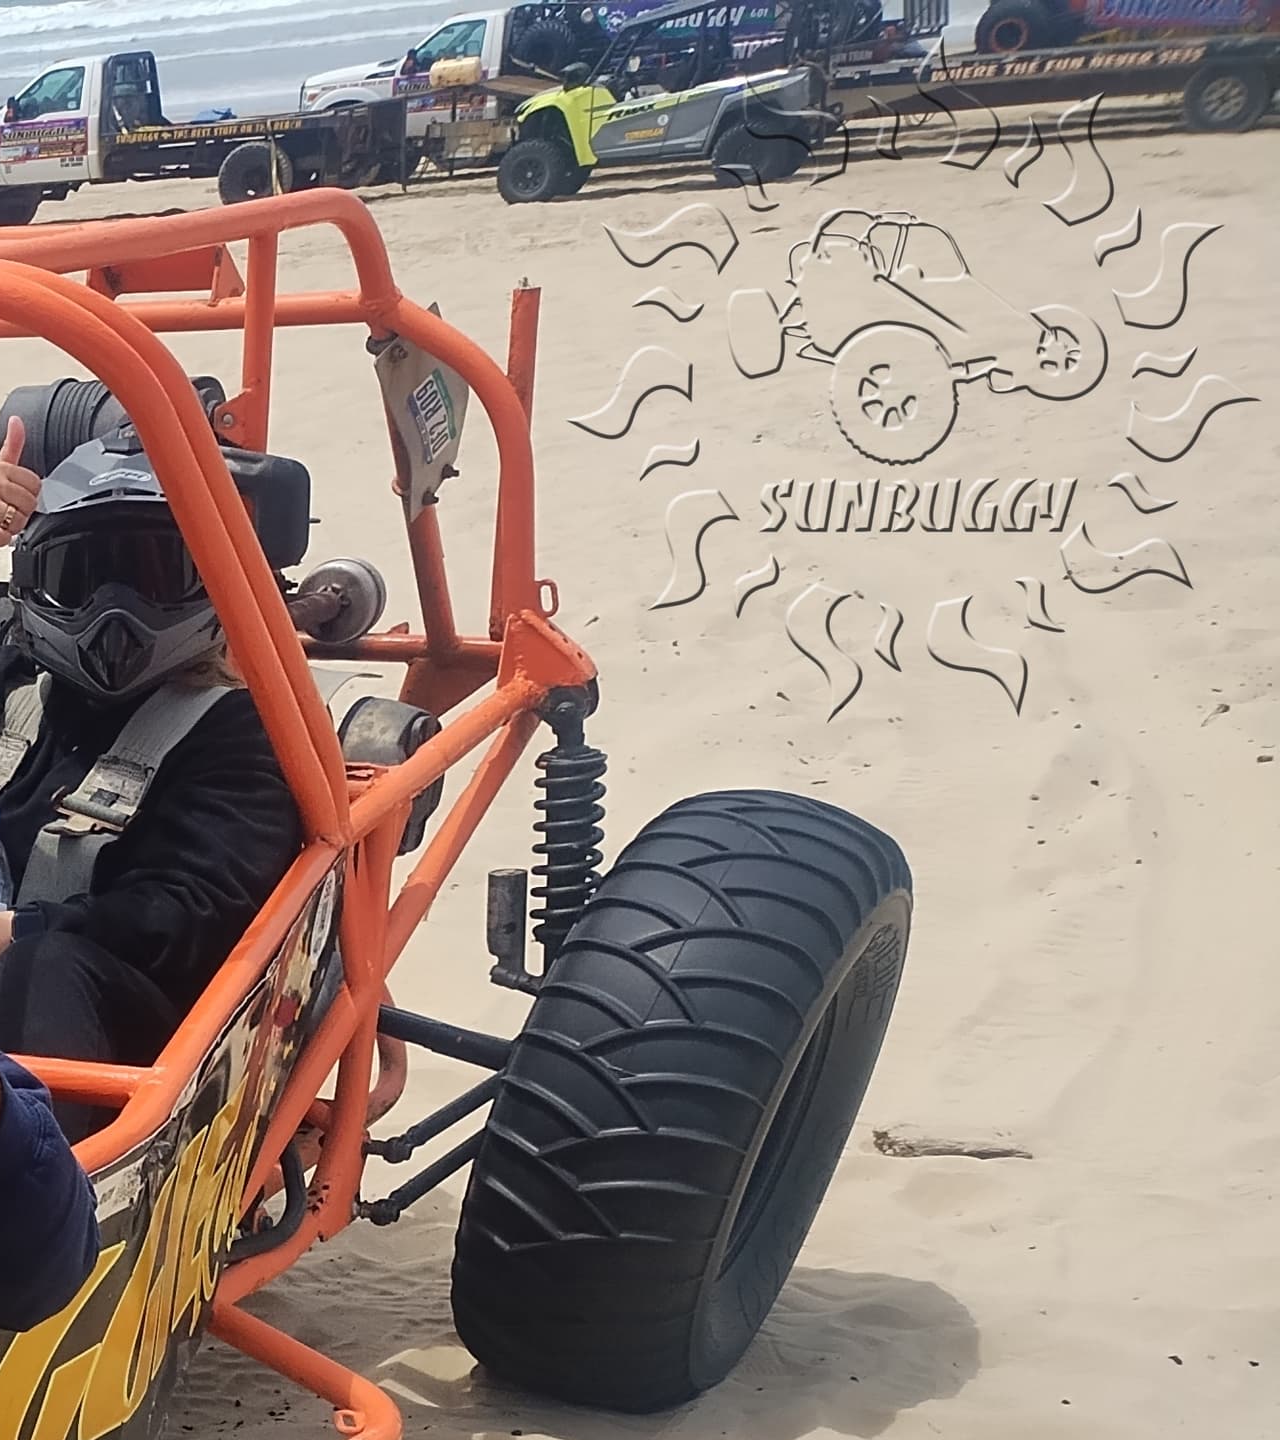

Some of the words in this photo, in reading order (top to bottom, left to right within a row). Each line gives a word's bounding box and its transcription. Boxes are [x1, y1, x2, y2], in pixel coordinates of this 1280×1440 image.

[931, 63, 997, 82] WHERE
[1004, 60, 1040, 76] THE
[1043, 56, 1086, 73] FUN
